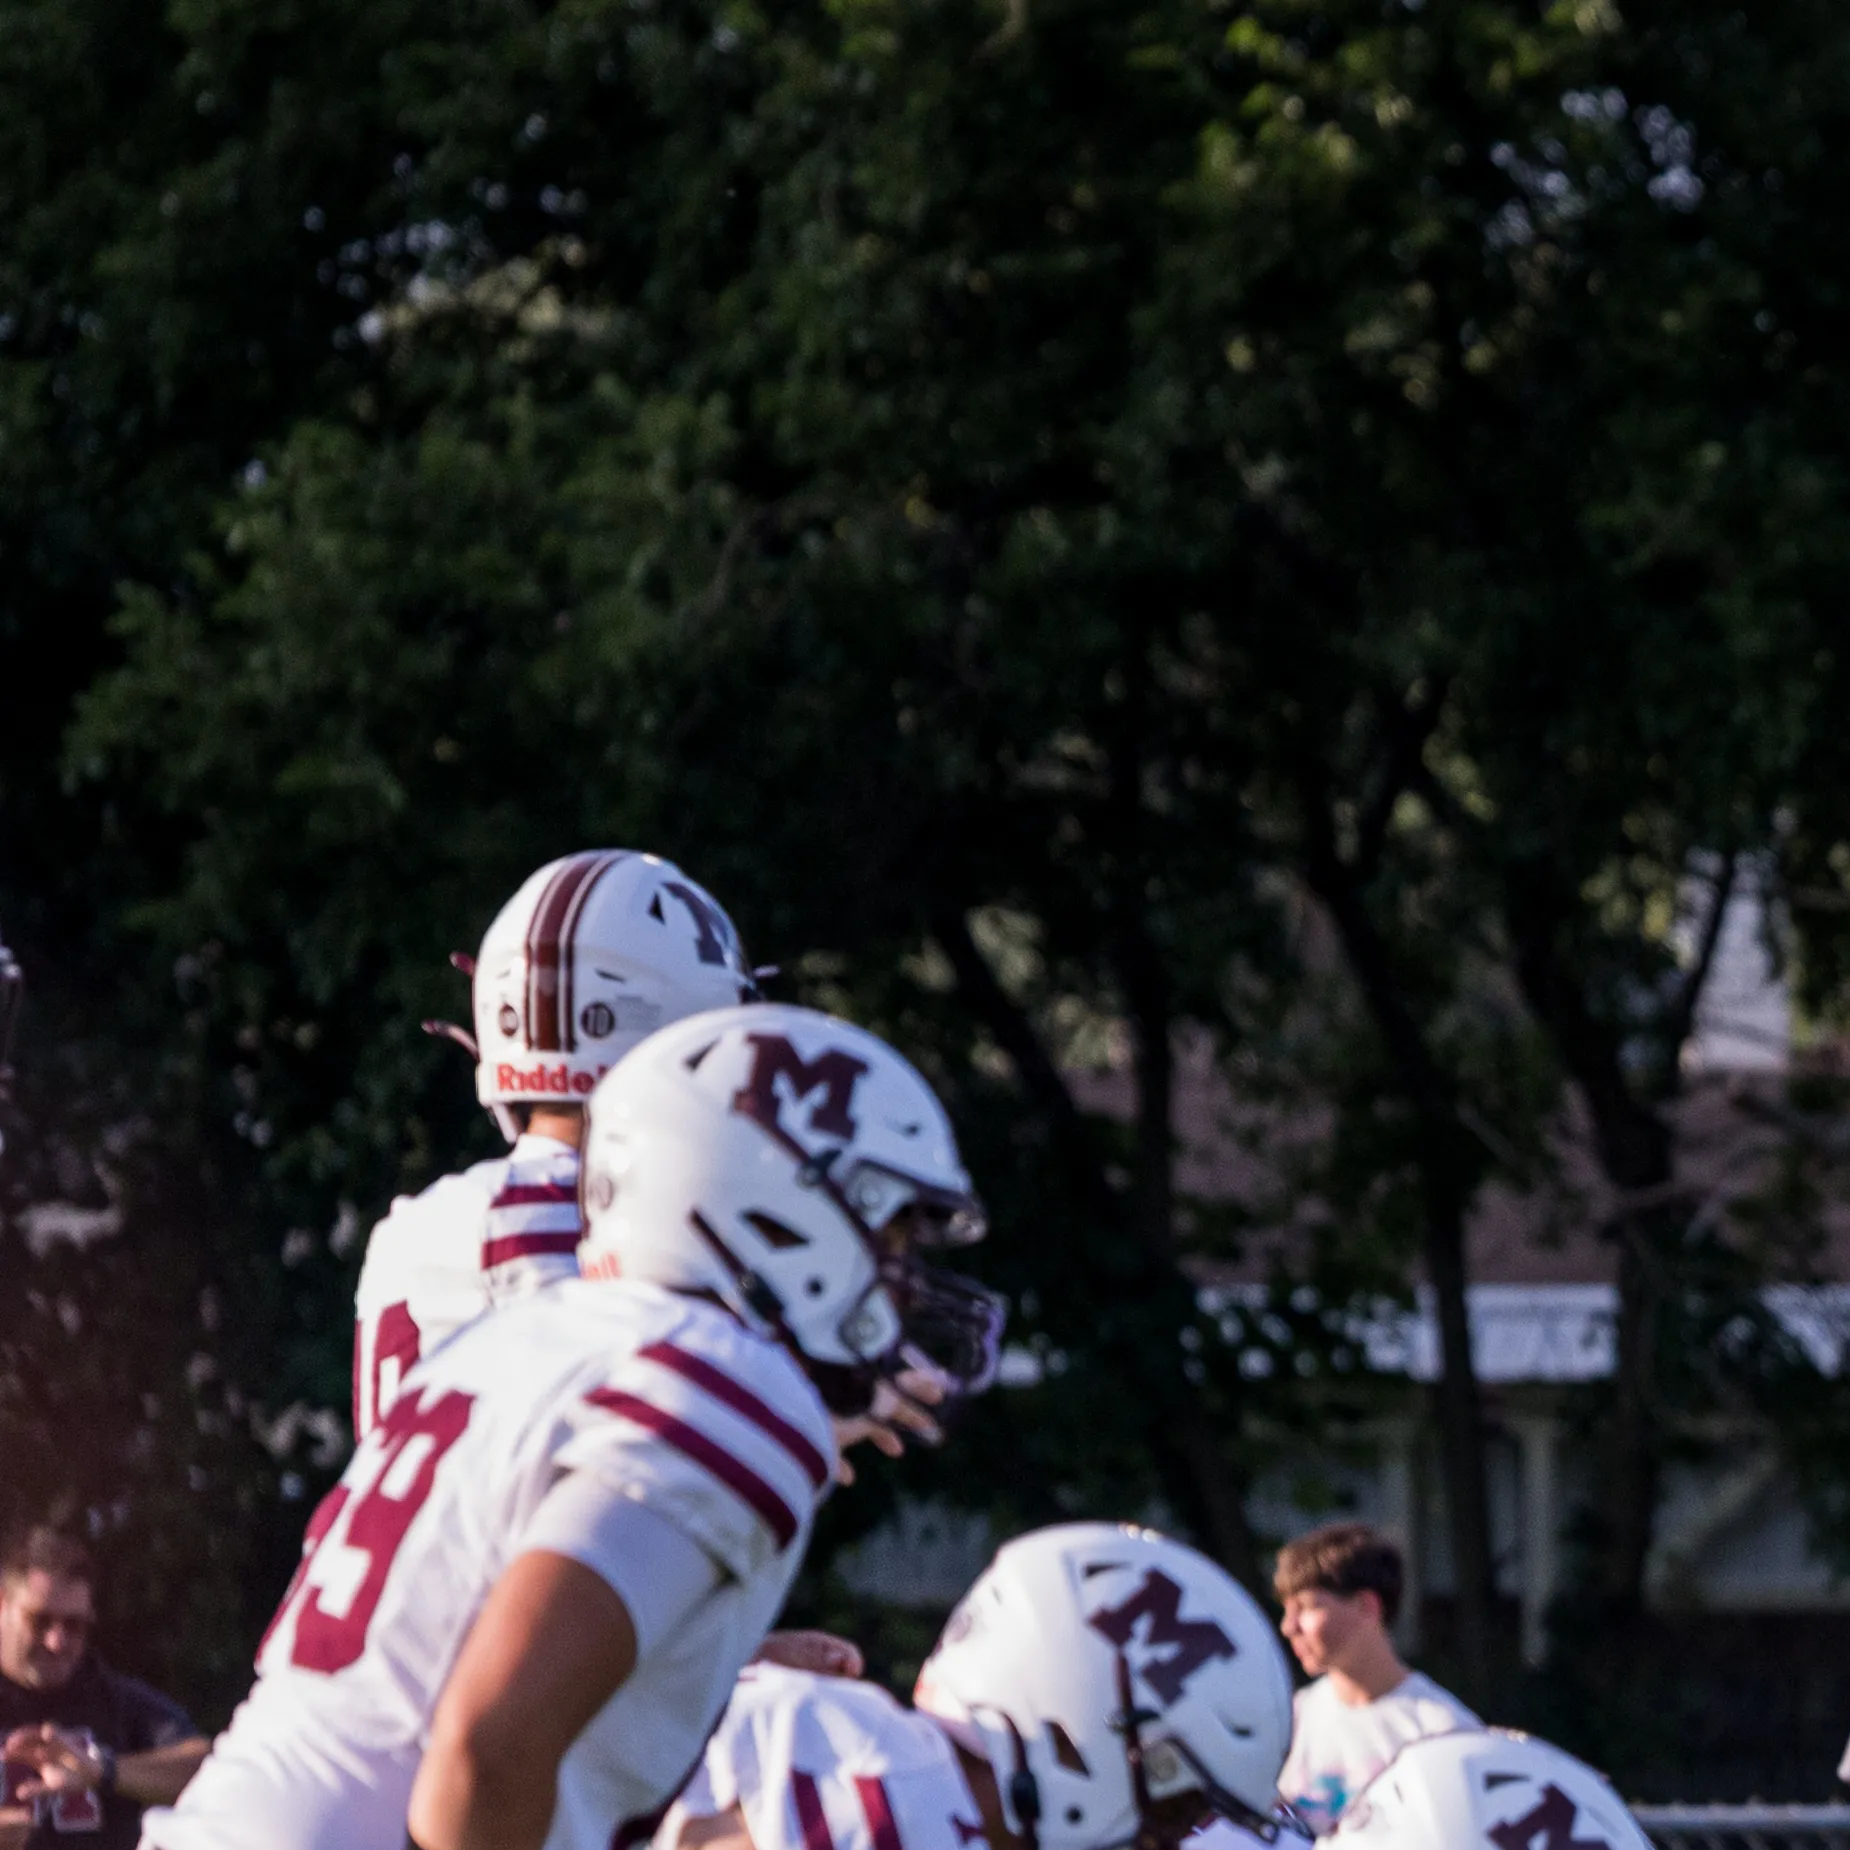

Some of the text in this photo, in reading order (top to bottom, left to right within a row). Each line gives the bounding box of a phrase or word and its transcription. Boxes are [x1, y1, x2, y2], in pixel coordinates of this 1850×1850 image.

[497, 1063, 607, 1094] Ridde
[731, 1032, 869, 1144] M
[1087, 1567, 1239, 1707] M
